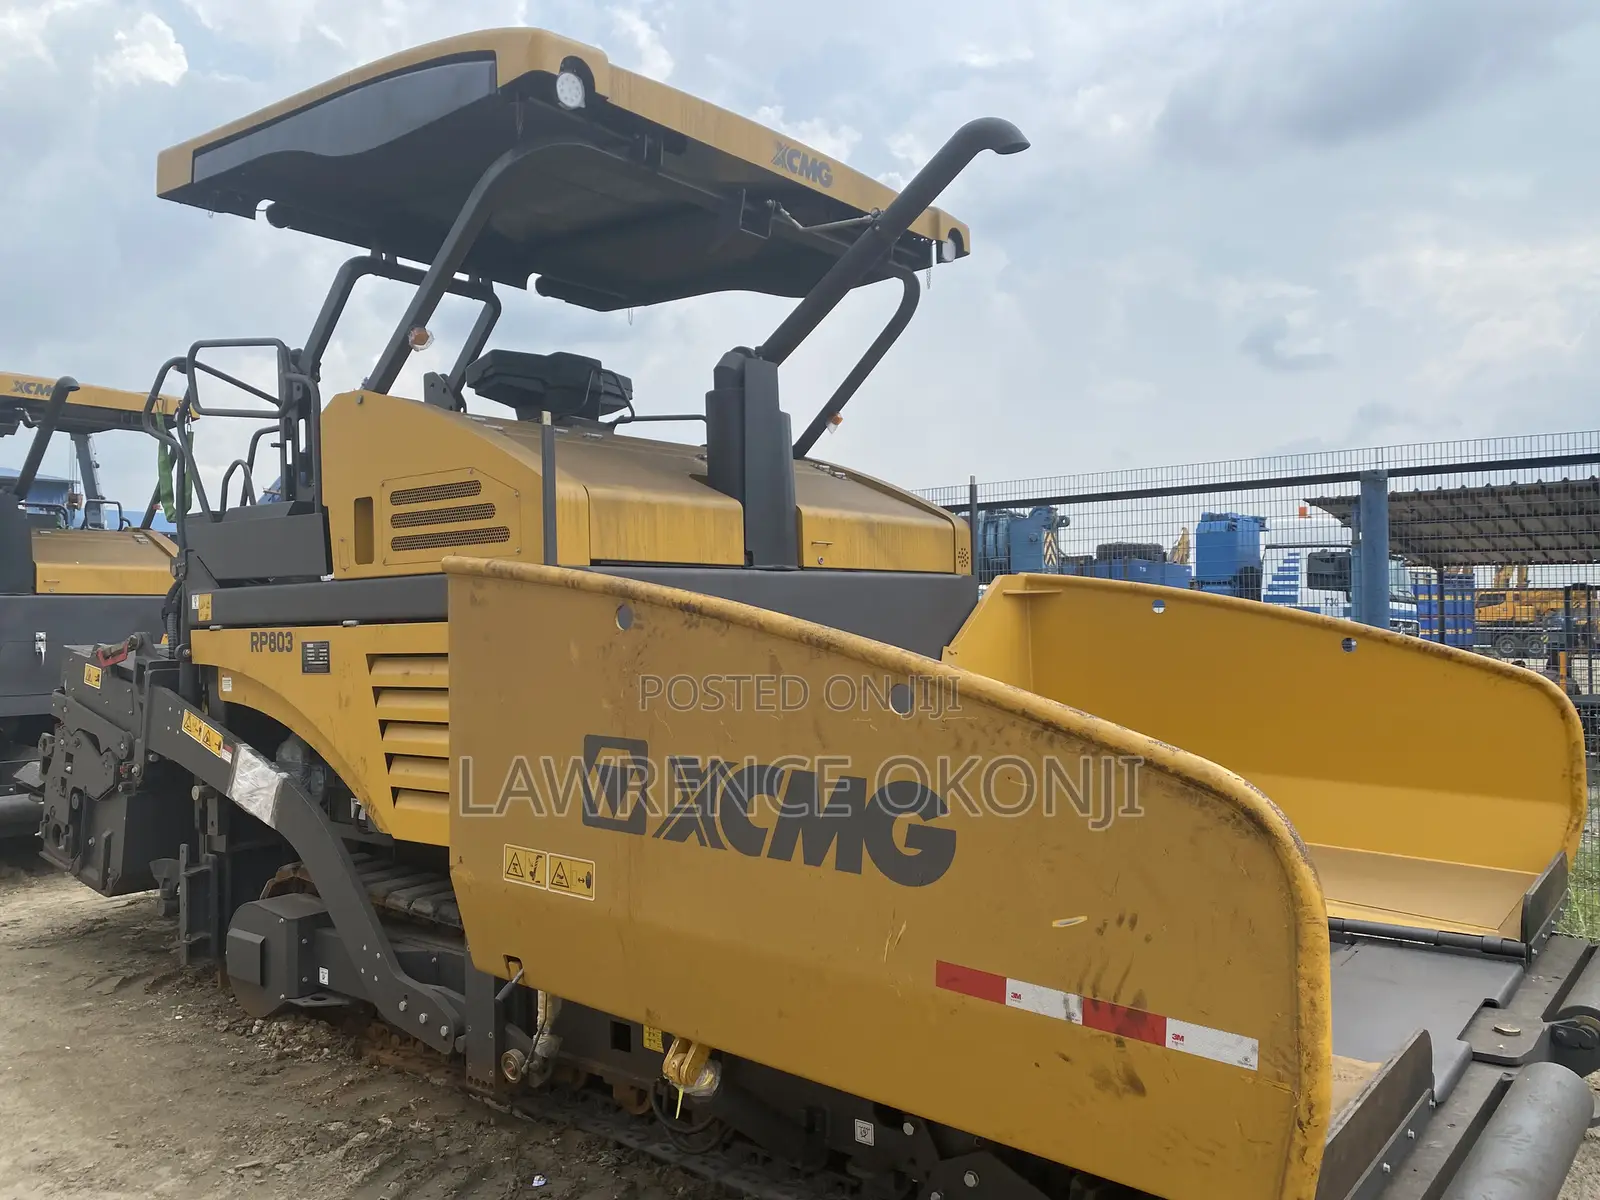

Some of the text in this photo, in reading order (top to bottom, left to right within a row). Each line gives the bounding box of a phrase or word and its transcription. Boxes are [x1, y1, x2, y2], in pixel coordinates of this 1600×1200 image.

[769, 140, 834, 189] XCMG
[10, 380, 56, 397] XCM
[250, 631, 294, 653] RP803
[652, 755, 957, 888] XCMG
[1010, 991, 1022, 1001] 3M
[1171, 1032, 1185, 1042] 3M
